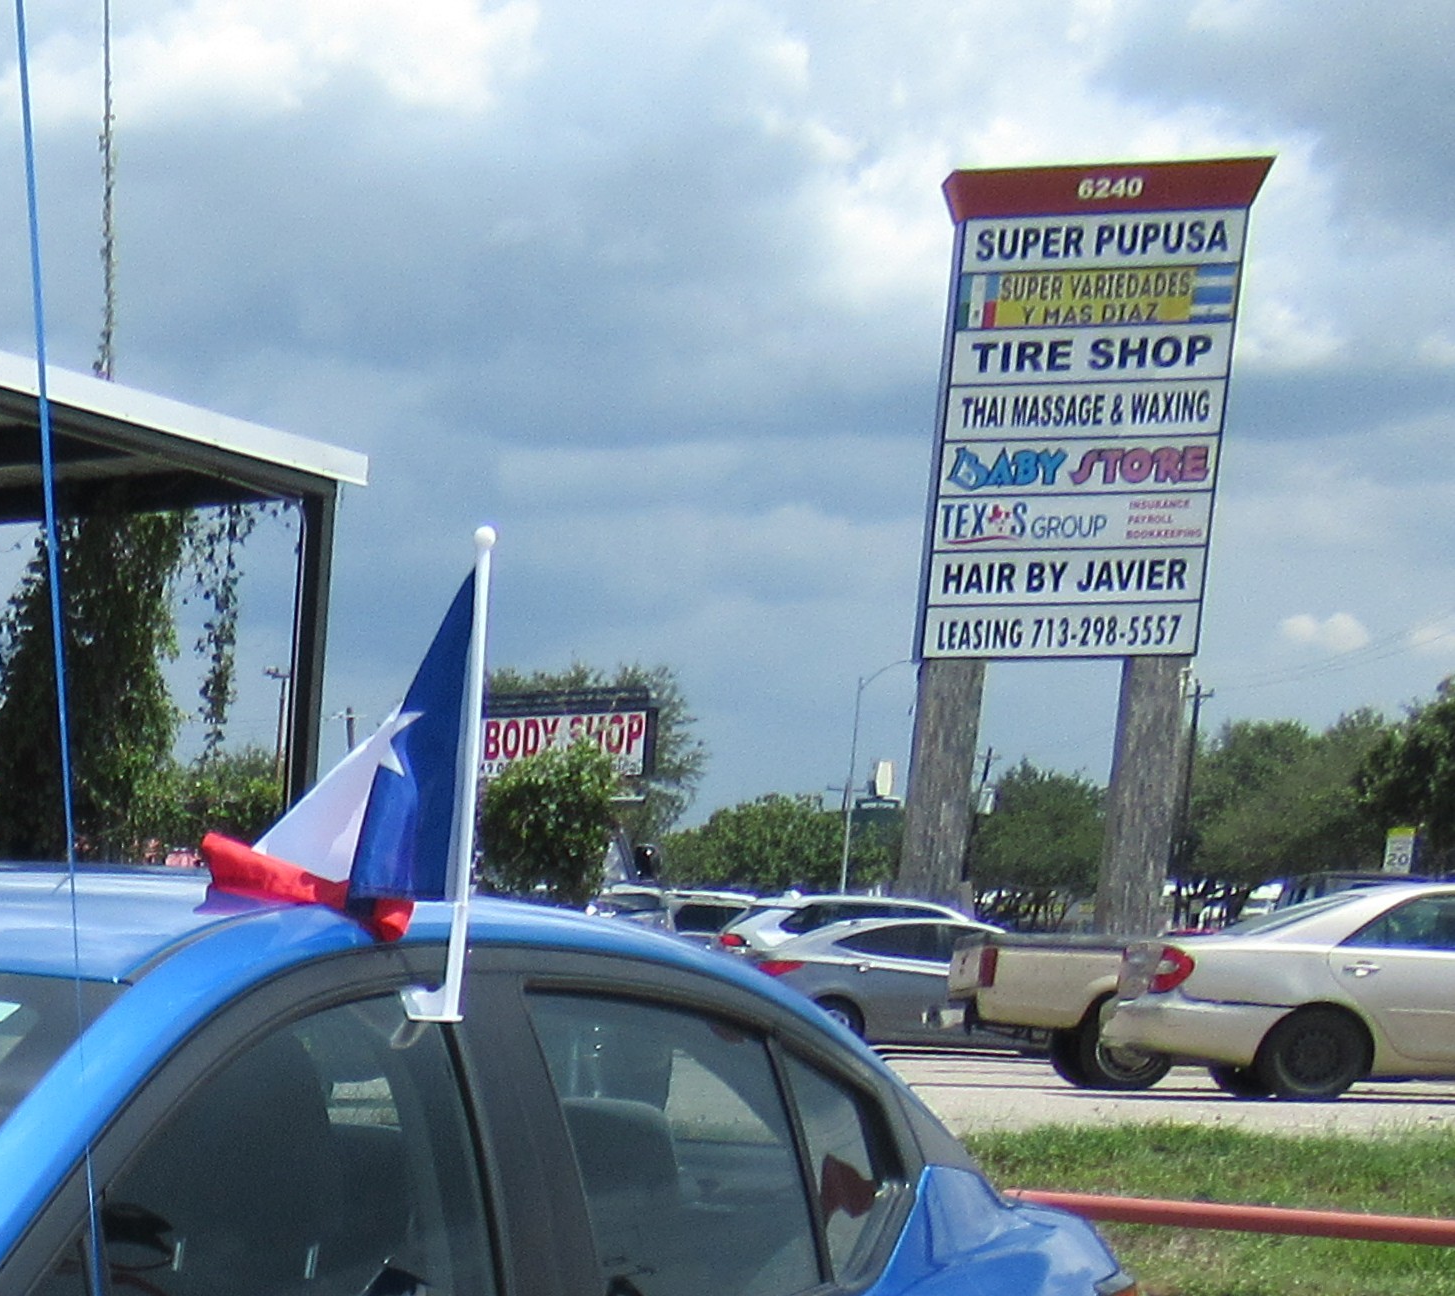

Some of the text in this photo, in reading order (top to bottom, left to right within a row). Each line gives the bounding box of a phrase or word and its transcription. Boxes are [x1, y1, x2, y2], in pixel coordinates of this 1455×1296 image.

[1077, 177, 1144, 199] 6240
[976, 220, 1228, 261] SUPER PUPUSA
[1000, 269, 1190, 301] SUPER VARIEDADES
[1020, 302, 1159, 325] Y MAS DIAZ
[972, 334, 1212, 372] TIRE SHOP
[962, 389, 1210, 428] THAI MASSAGE & WAXING
[948, 446, 1210, 491] BABY STORE
[941, 501, 1108, 539] TEXS GROUP
[941, 558, 1187, 594] HAIR BY JAVIER
[937, 614, 1182, 651] LEASING 713-298-5557
[484, 716, 561, 760] BODY
[1387, 852, 1410, 867] 20
